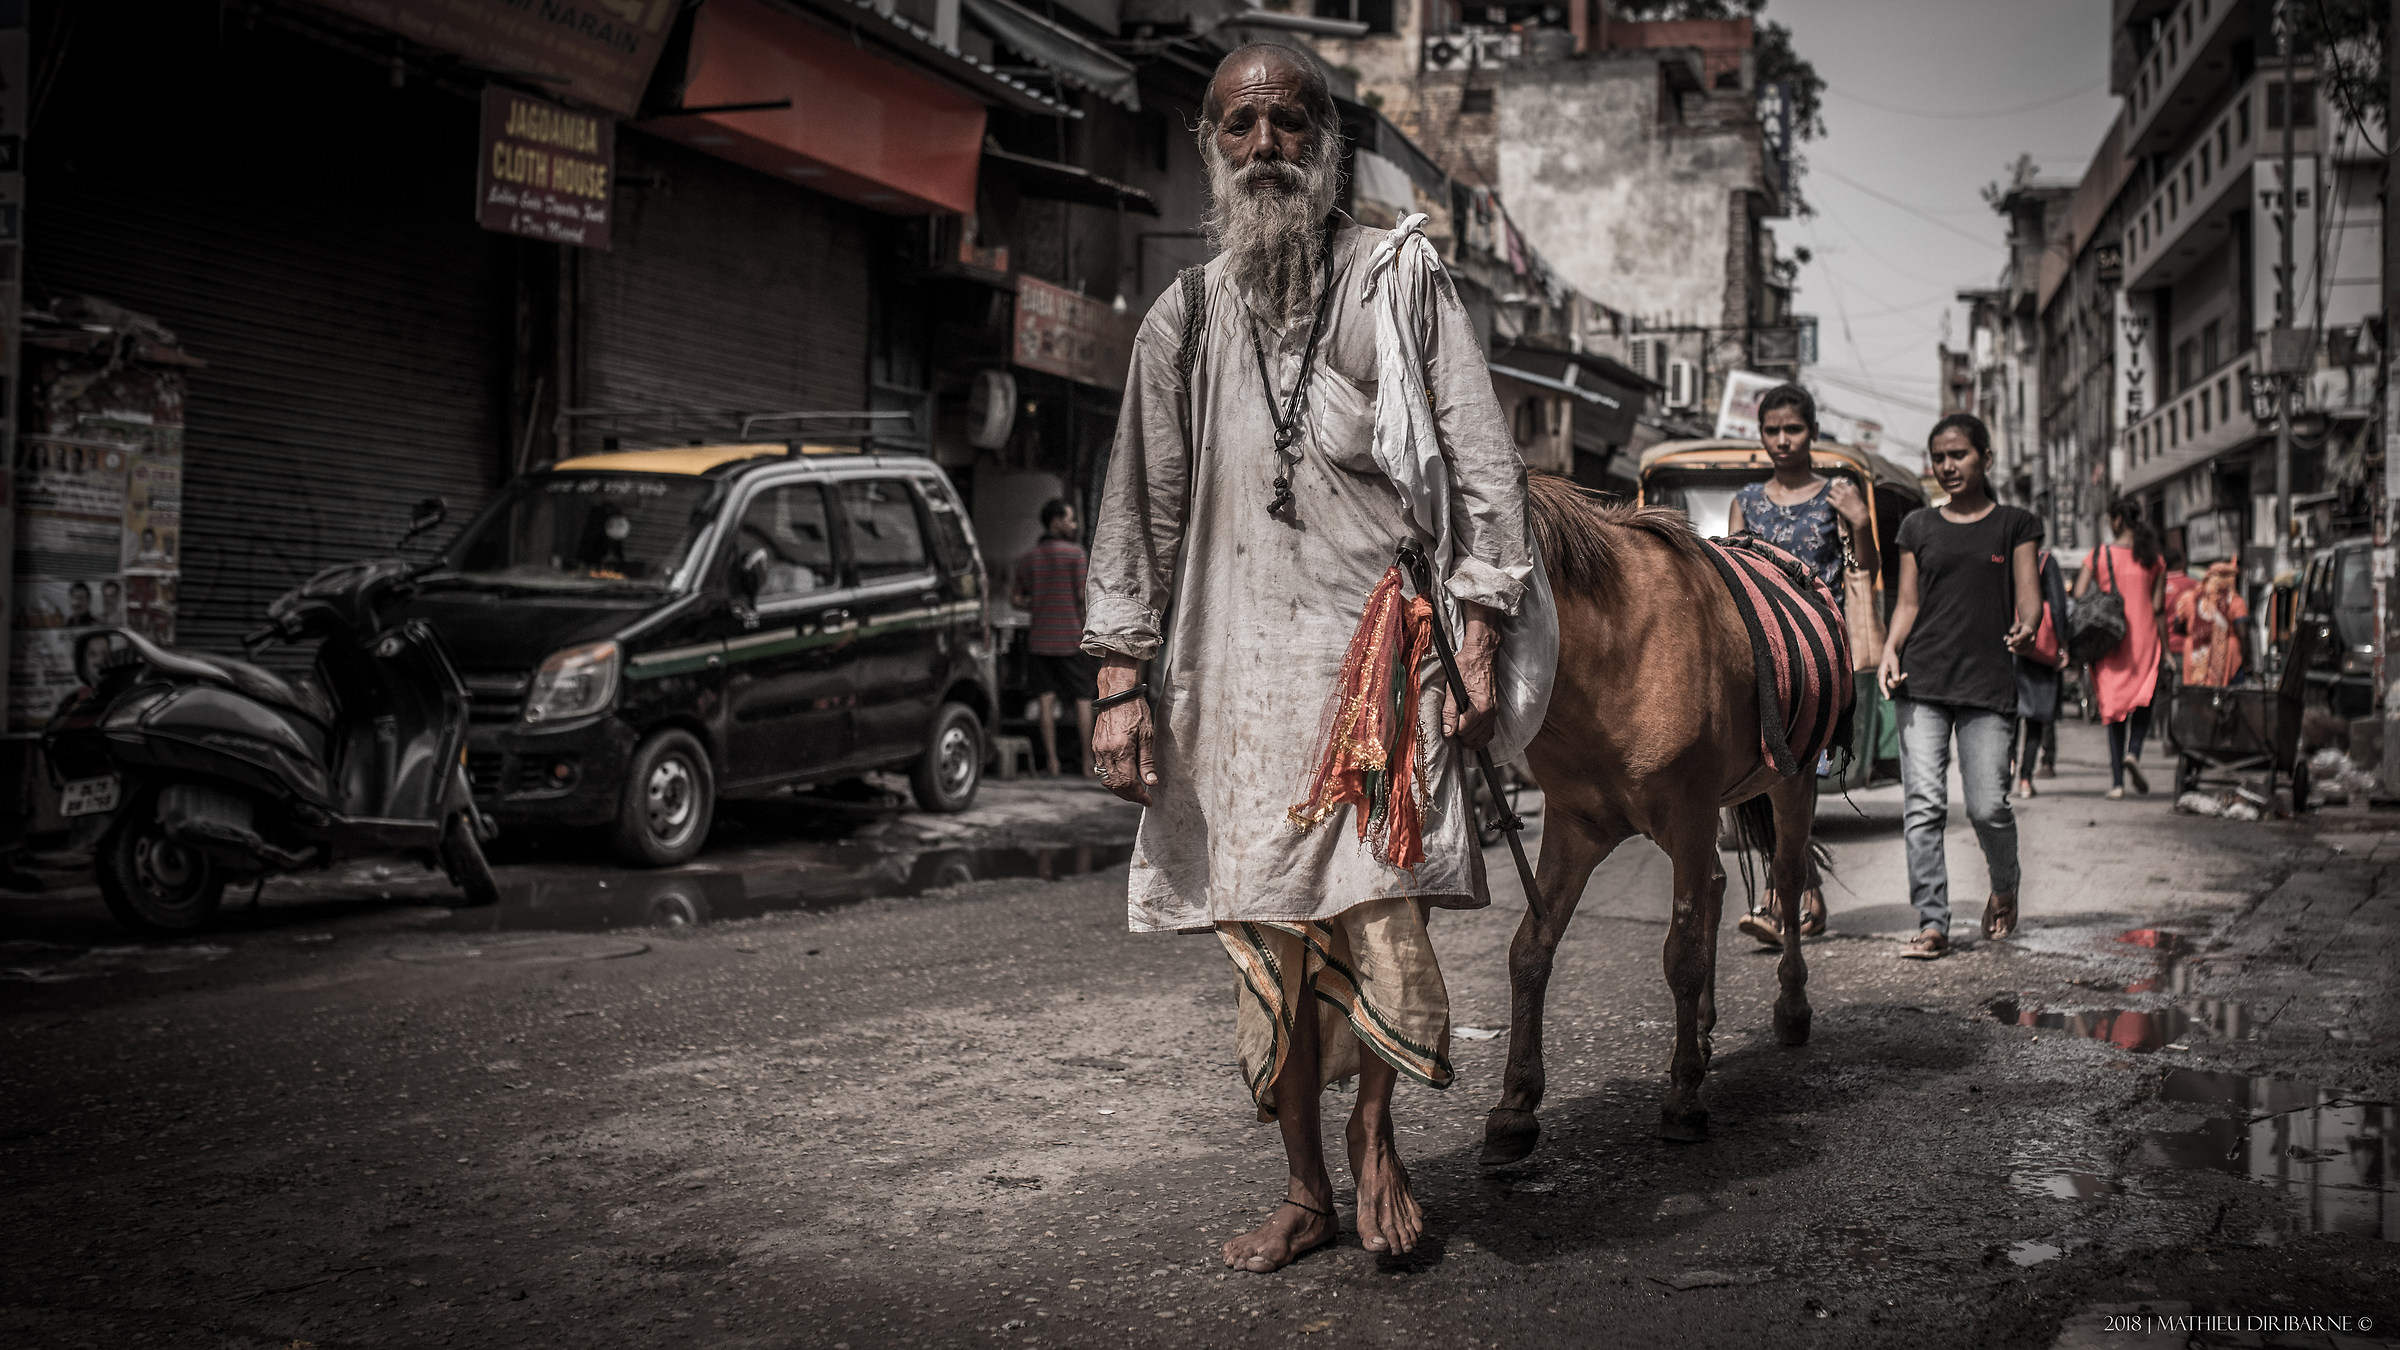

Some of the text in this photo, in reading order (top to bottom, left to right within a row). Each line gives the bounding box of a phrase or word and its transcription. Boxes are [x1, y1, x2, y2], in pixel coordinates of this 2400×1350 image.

[539, 0, 640, 53] NARAIN
[505, 98, 599, 154] JAGDAMBA
[492, 139, 608, 200] CLOTH HOUSE
[2120, 317, 2150, 327] THE
